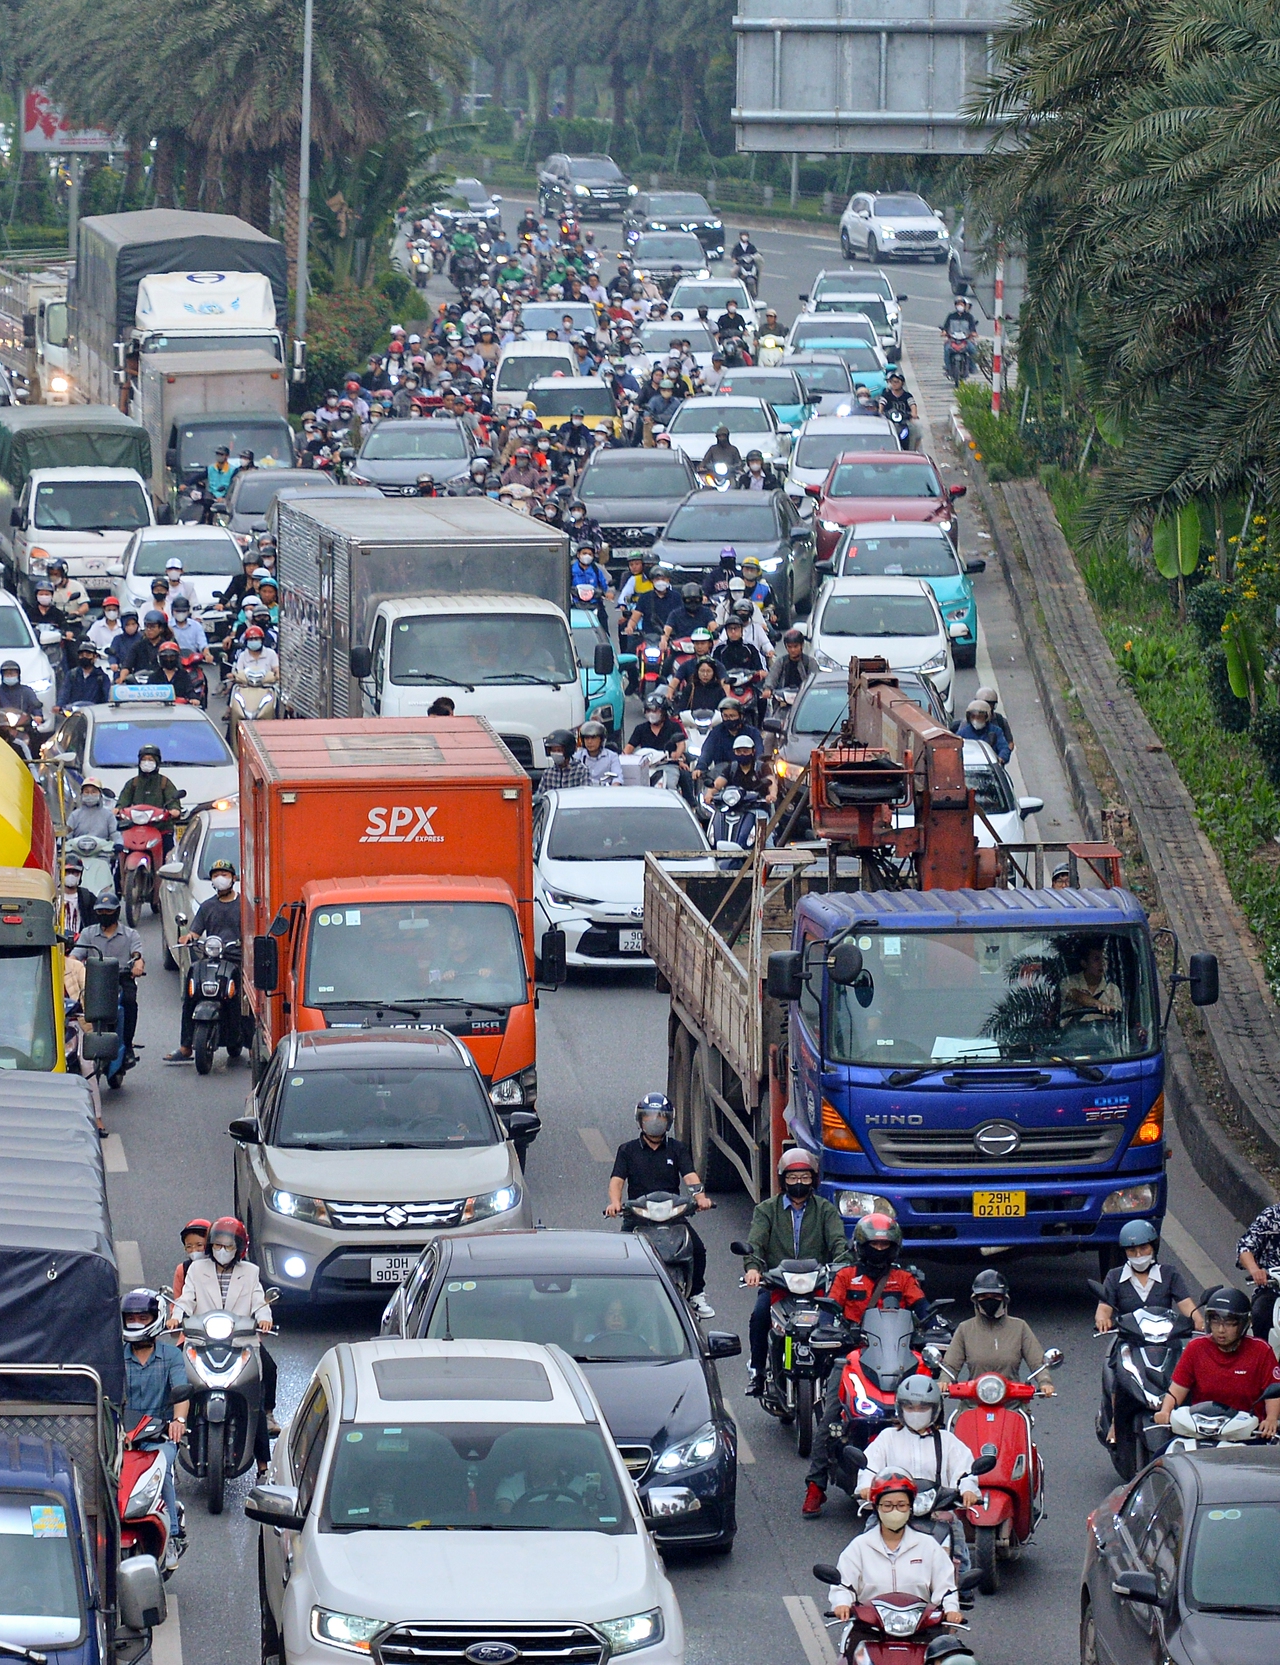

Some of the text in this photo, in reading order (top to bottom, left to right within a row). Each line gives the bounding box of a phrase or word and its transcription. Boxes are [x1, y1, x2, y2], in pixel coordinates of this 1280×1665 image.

[363, 807, 439, 841] SPX
[865, 1114, 923, 1125] HINO
[988, 1193, 1011, 1204] 29H
[978, 1205, 1020, 1216] 021.02
[386, 1258, 409, 1269] 30H
[478, 1647, 506, 1659] Ford
